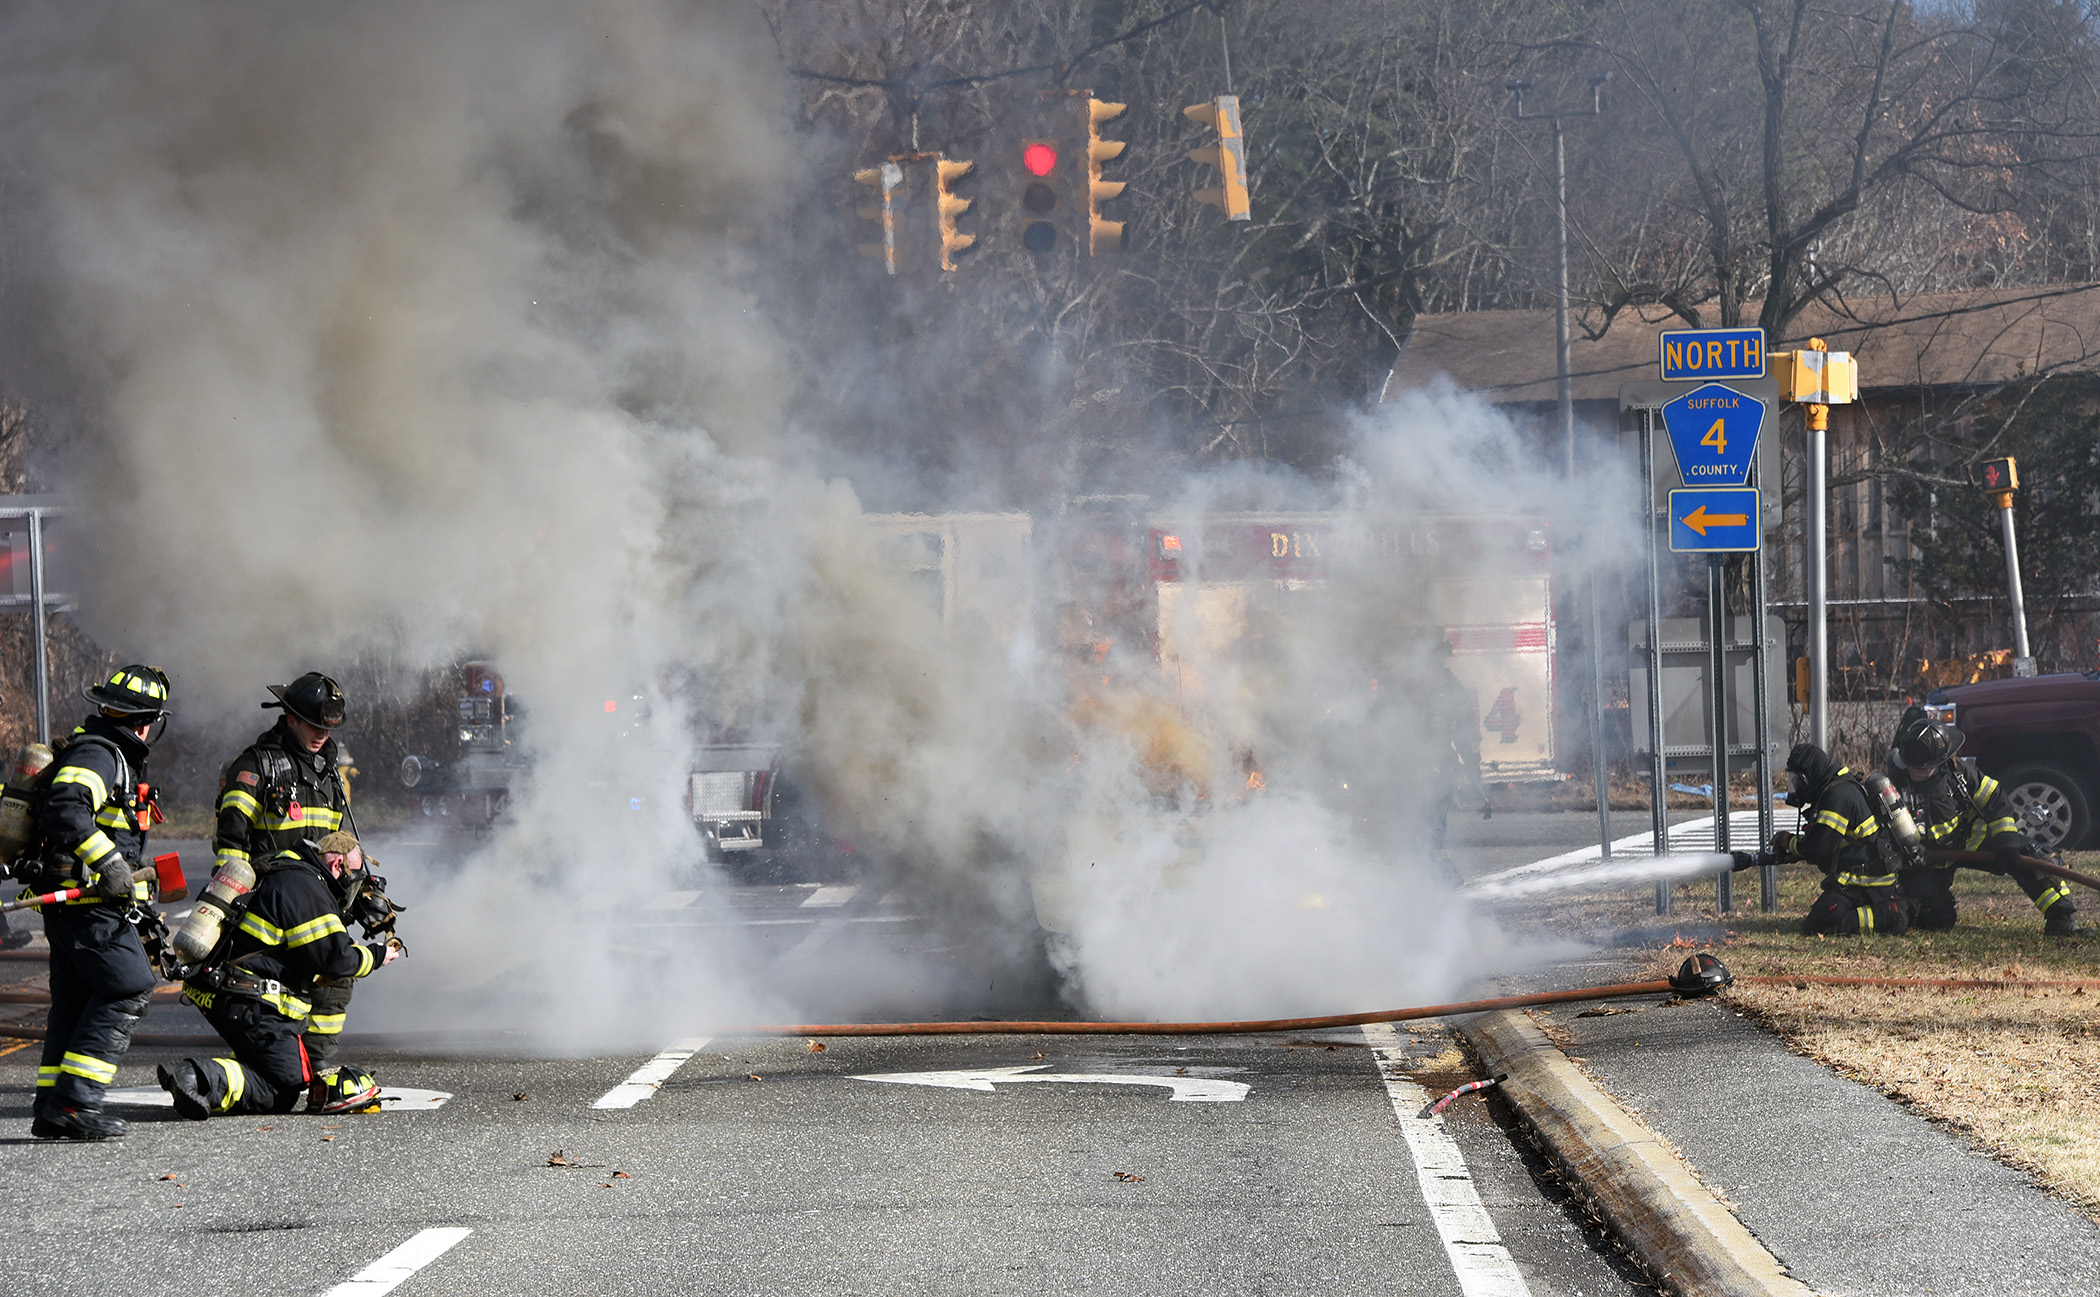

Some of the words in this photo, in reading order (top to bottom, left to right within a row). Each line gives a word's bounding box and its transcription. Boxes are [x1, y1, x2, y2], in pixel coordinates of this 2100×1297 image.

[1666, 339, 1760, 371] NORTH
[1687, 398, 1740, 410] SUFFOLK
[1700, 418, 1728, 455] 4
[1691, 464, 1738, 476] COUNTY
